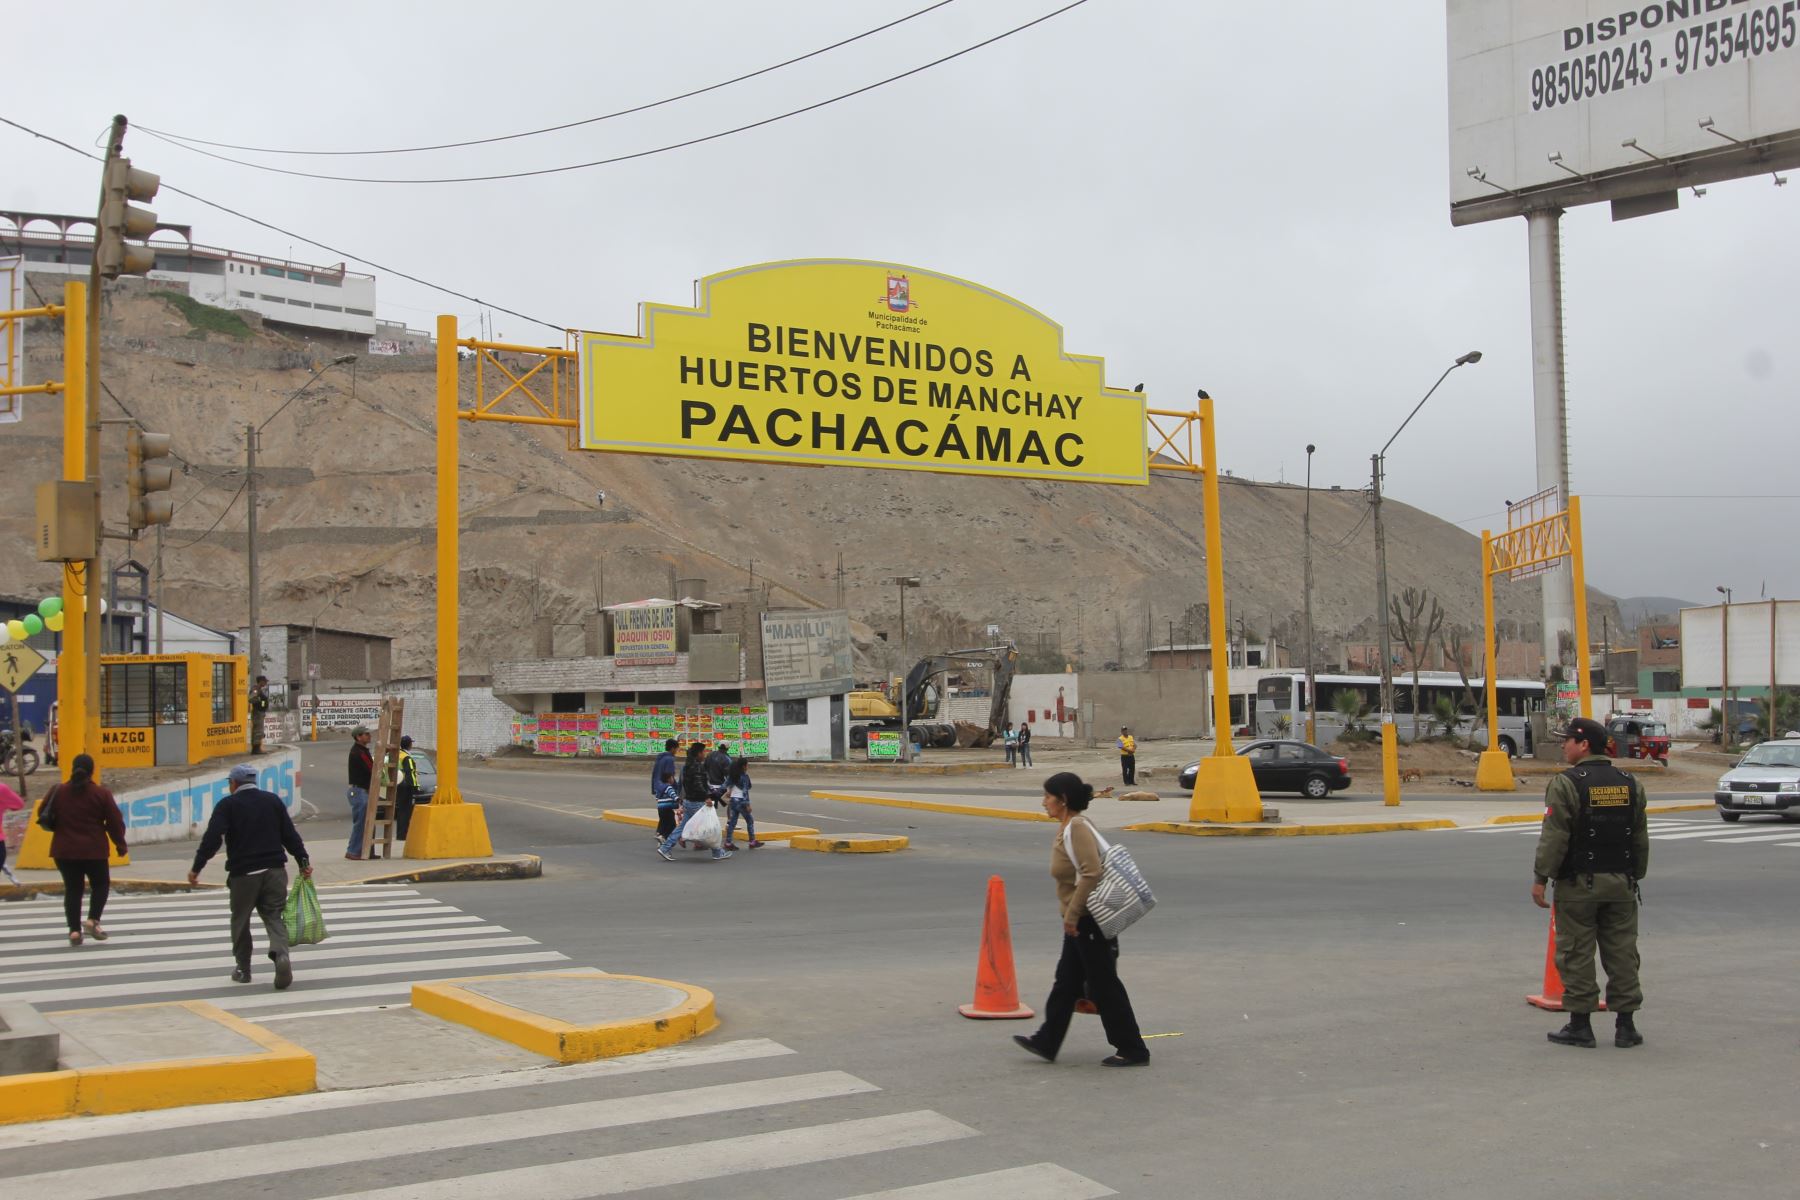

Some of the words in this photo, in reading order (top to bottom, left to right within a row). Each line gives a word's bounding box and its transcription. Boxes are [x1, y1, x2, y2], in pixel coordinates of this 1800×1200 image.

[1564, 0, 1750, 50] DISPONIB
[1531, 39, 1653, 112] 985050243
[1675, 0, 1800, 75] 97554695
[868, 311, 918, 325] Municipalidad
[918, 318, 928, 326] de
[748, 322, 994, 378] BIENVENIDOS
[1010, 354, 1032, 382] A
[680, 355, 862, 401] HUERTOS
[873, 375, 918, 406] DE
[928, 381, 1083, 420] MANCHAY
[681, 399, 1085, 468] PACHACÁMAC
[652, 608, 660, 628] DE
[616, 630, 648, 643] JOAQUIN
[206, 724, 242, 737] SERENAZGO
[102, 746, 125, 754] AUXILIO
[127, 745, 151, 753] RAPIDO
